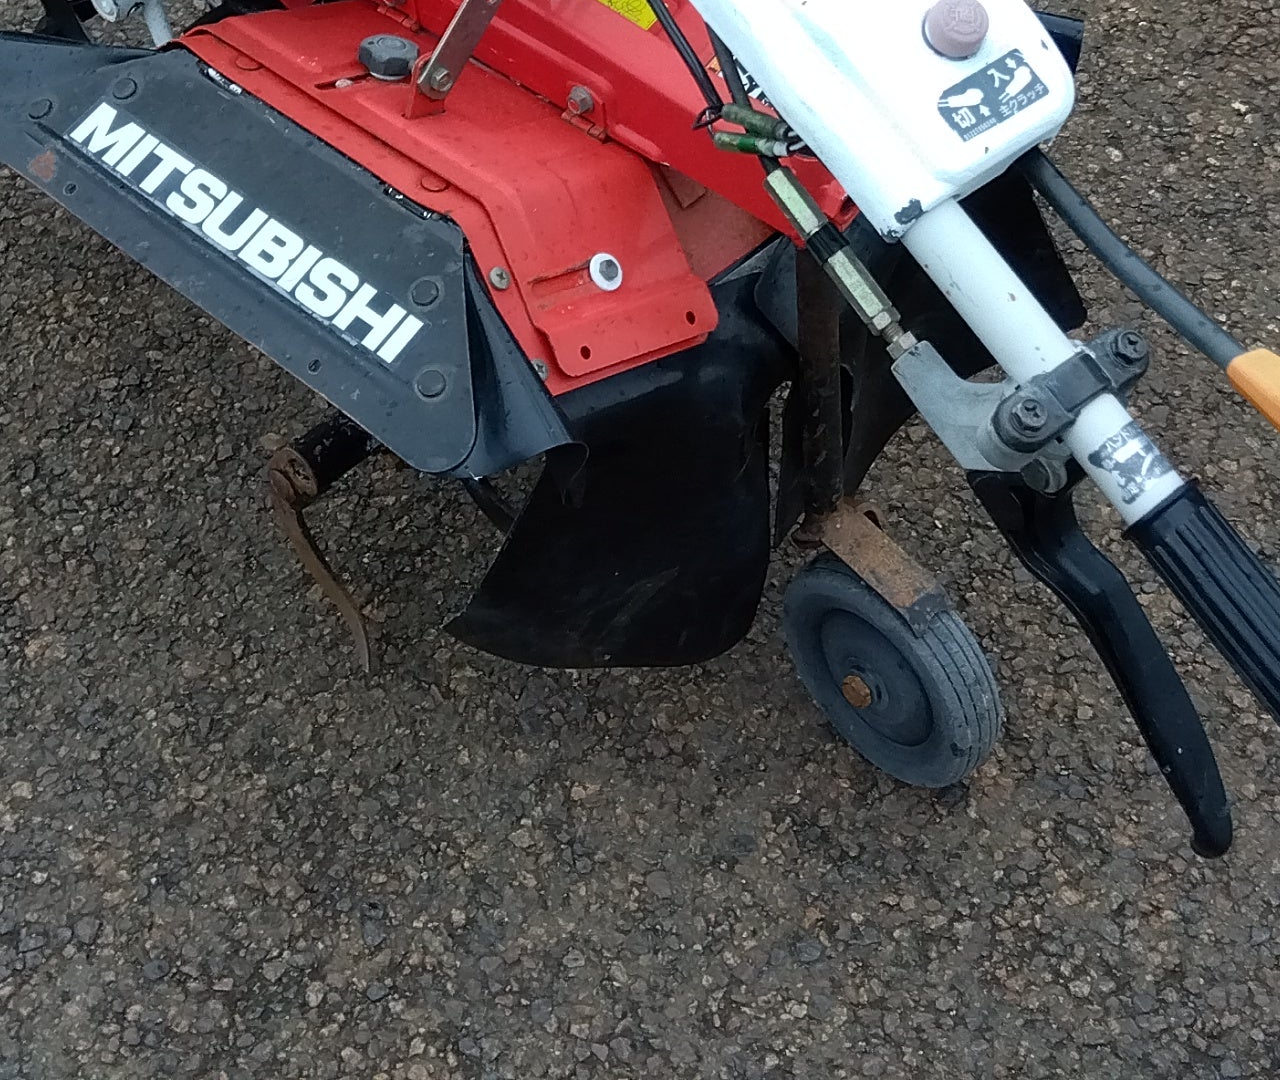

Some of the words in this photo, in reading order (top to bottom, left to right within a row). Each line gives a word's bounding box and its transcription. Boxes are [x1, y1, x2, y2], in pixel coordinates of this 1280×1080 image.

[987, 68, 1010, 88] 入
[998, 83, 1045, 117] 主クラッチ
[951, 107, 976, 129] 切
[69, 102, 424, 364] MITSUBISHI
